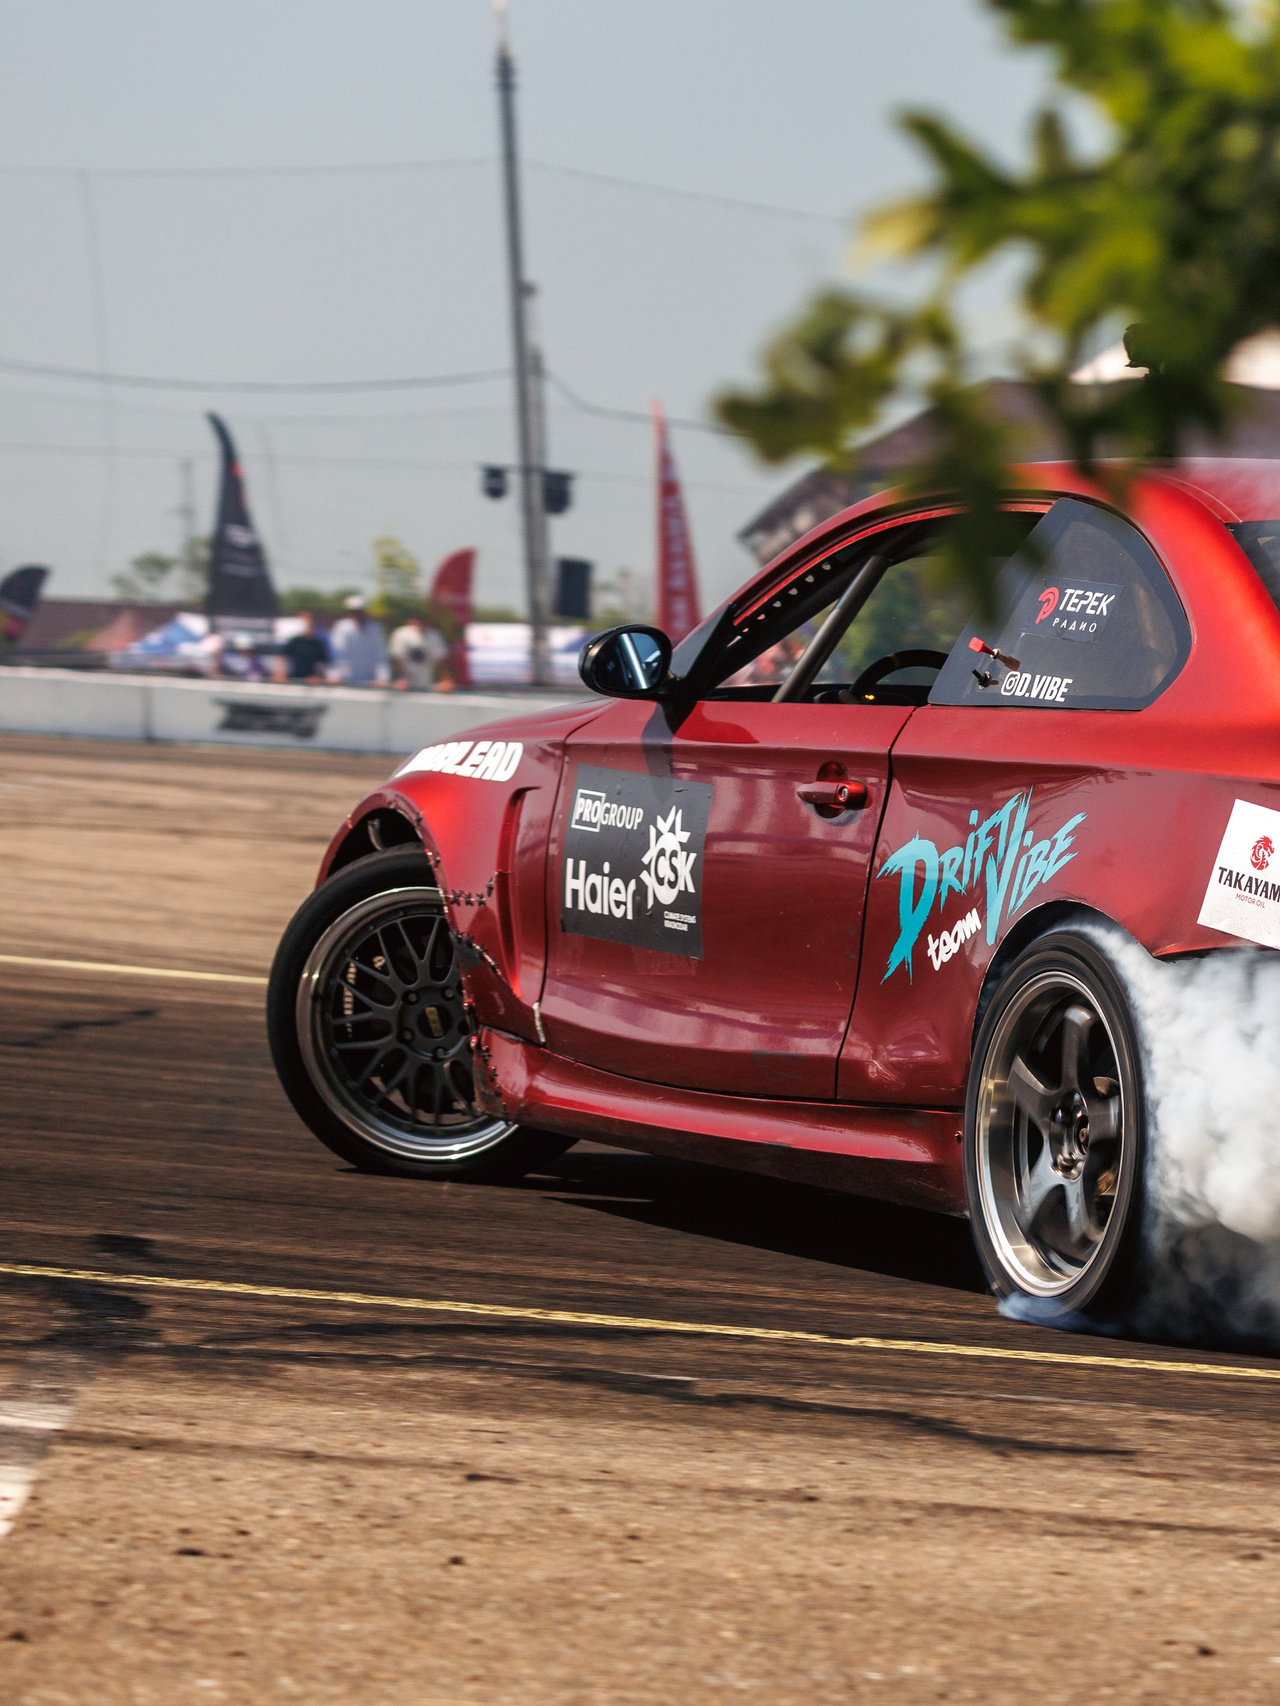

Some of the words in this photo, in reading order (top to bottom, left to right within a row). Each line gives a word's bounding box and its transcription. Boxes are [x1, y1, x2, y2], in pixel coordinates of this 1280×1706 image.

[1058, 588, 1116, 617] ТЕРЕК
[1052, 617, 1098, 633] РАДИО
[564, 857, 637, 920] Haier
[1235, 893, 1256, 905] MOTOR
[927, 907, 982, 971] team
